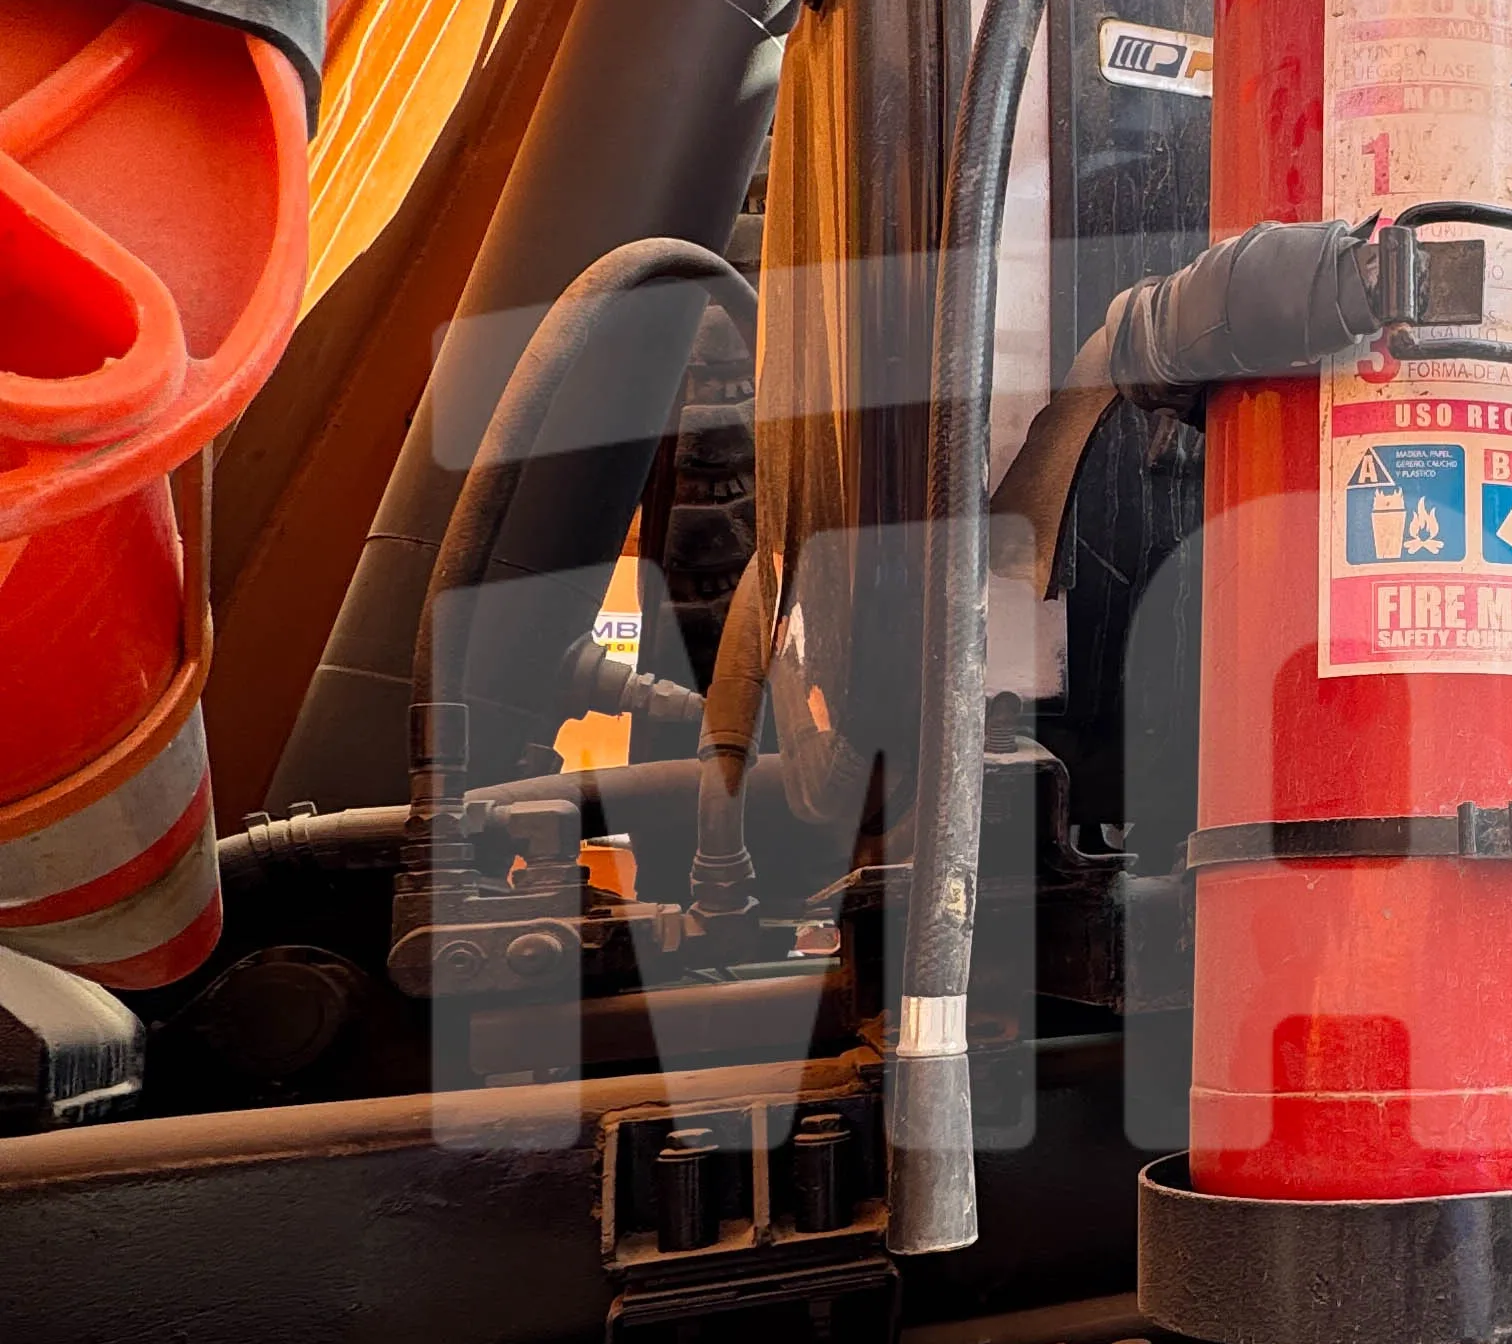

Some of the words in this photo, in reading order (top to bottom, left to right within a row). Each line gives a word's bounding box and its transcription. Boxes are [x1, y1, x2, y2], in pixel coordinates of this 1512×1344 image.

[1419, 62, 1477, 80] CLASE
[1361, 132, 1391, 196] 1
[1394, 402, 1453, 428] USO
[1357, 454, 1380, 484] A
[1491, 451, 1512, 480] B
[1376, 585, 1466, 631] FIRE
[1376, 628, 1450, 649] SAFETY
